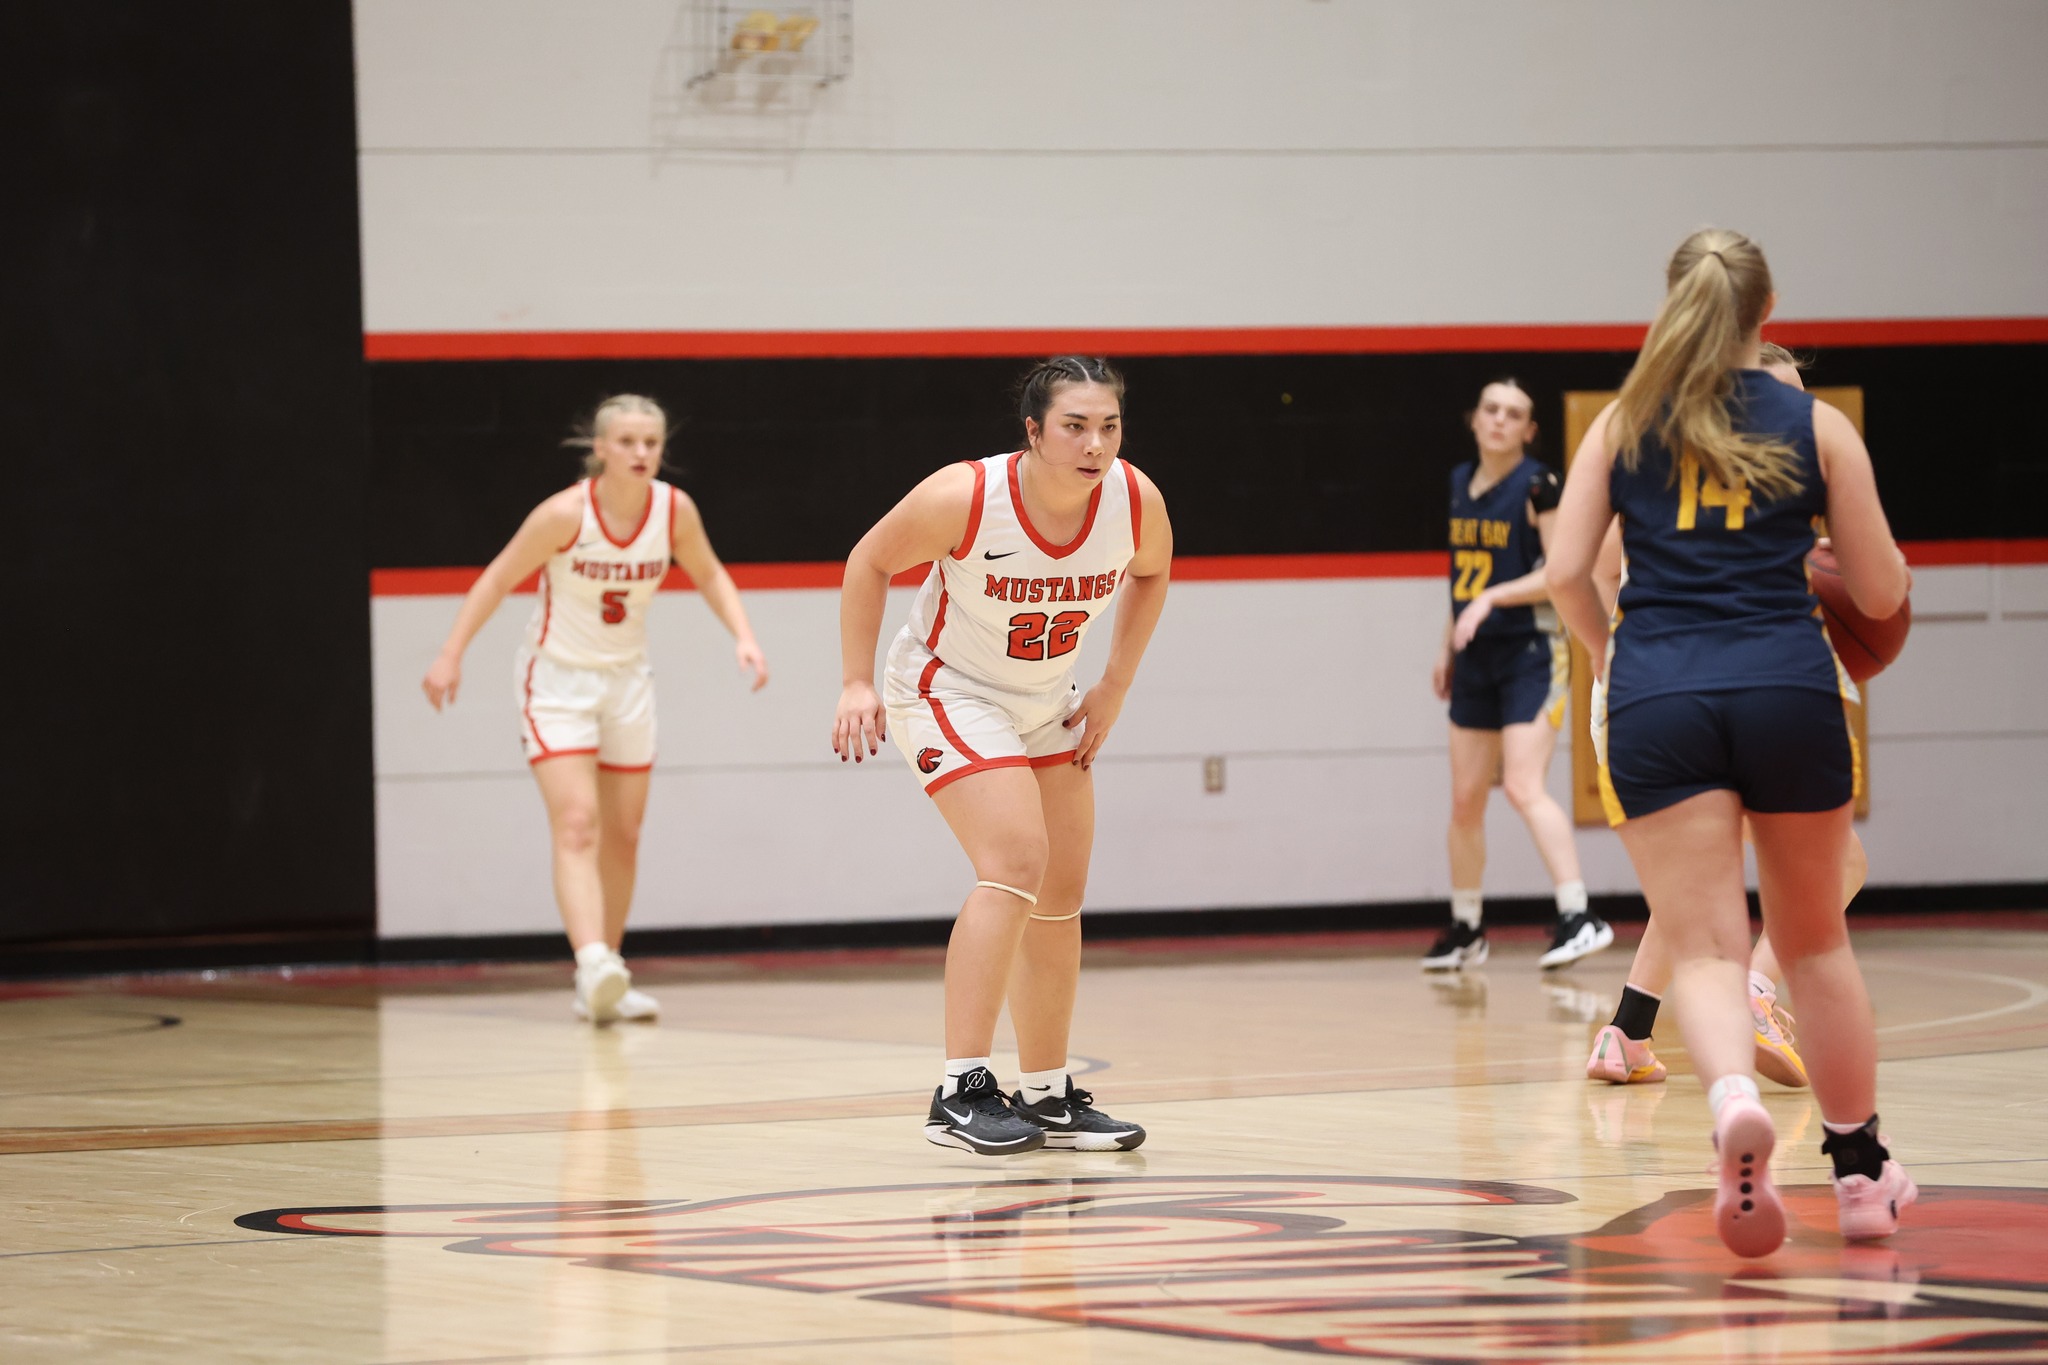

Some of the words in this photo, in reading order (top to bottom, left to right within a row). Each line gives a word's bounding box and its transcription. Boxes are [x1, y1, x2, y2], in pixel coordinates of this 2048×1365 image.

[1676, 445, 1752, 530] 14
[572, 559, 662, 580] MUSTANGS
[984, 569, 1117, 603] MUSTANGS
[1453, 550, 1493, 601] 22
[602, 590, 629, 624] 5
[1006, 610, 1091, 661] 22
